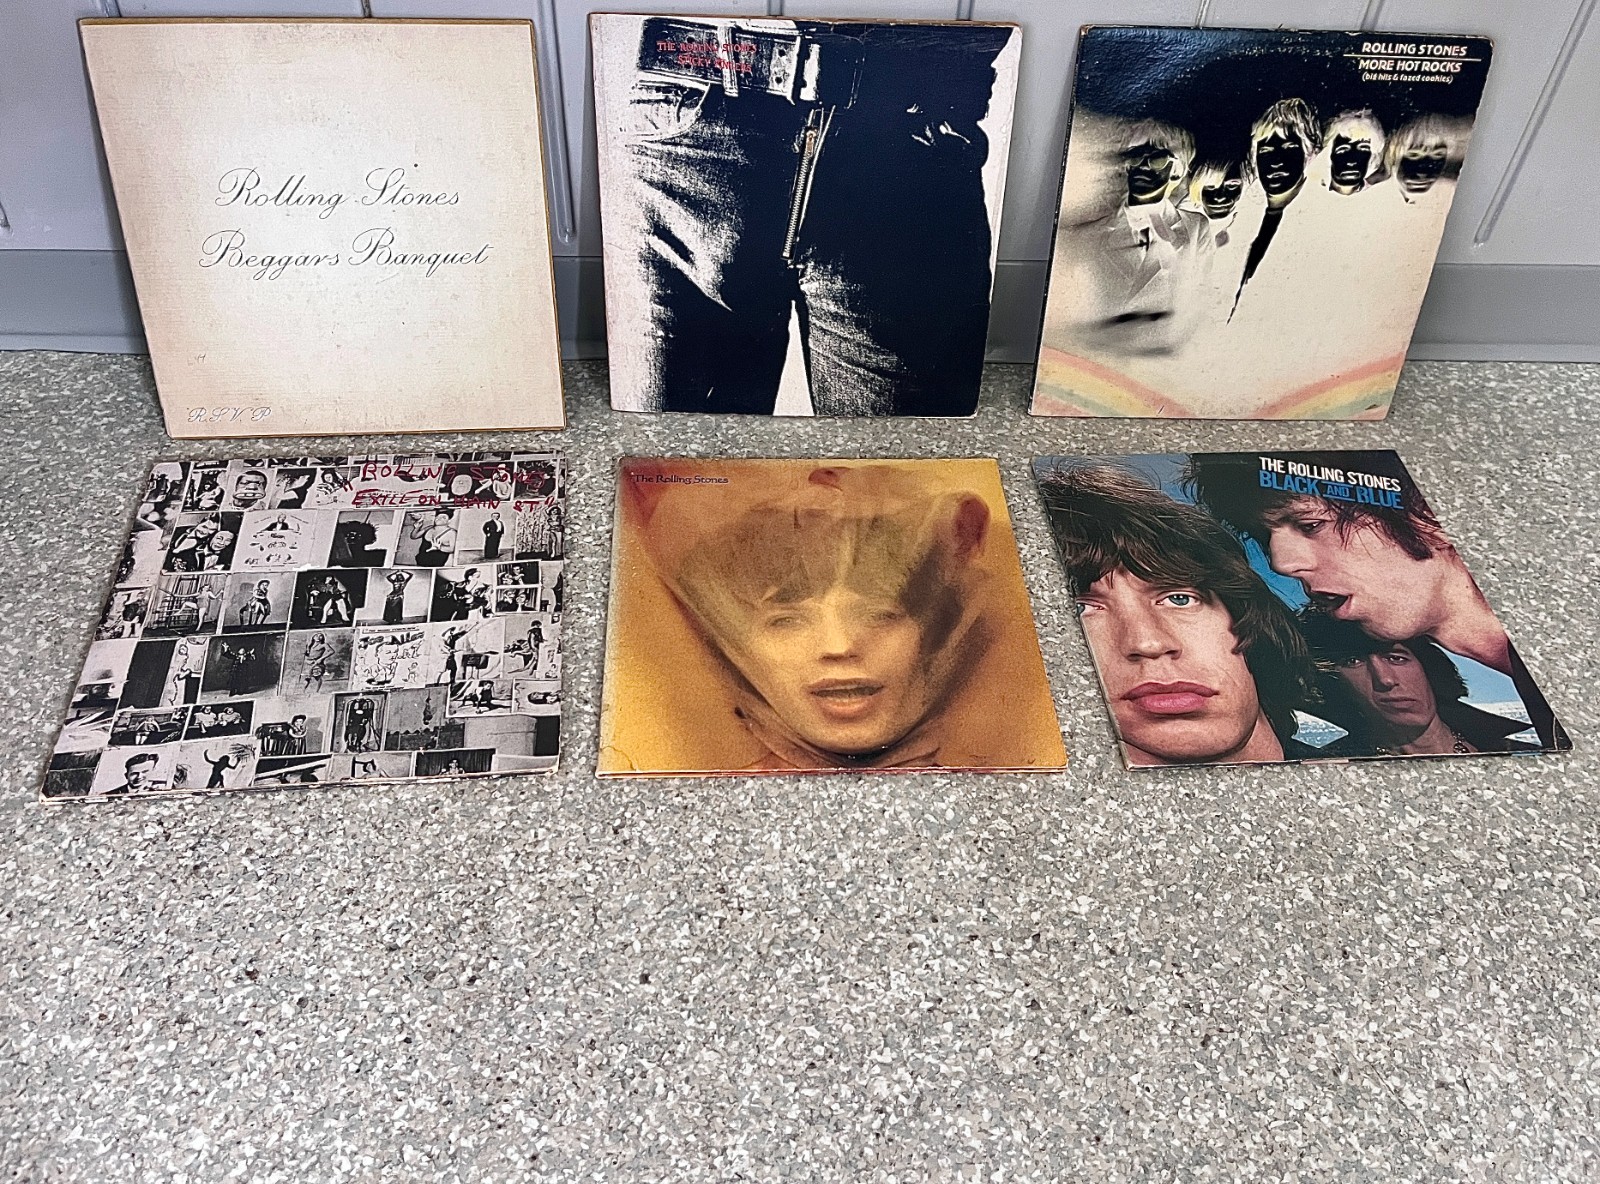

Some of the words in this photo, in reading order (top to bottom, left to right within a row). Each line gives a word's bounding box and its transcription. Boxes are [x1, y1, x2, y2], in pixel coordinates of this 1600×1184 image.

[656, 41, 677, 52] THE
[1362, 42, 1416, 54] ROLLING
[1418, 44, 1468, 56] STONES
[1359, 59, 1395, 71] MORE
[1396, 61, 1422, 72] HOT
[1421, 61, 1462, 72] ROCKS
[215, 167, 350, 219] Rolling
[361, 167, 459, 205] Stones
[199, 228, 340, 280] Beggars
[348, 227, 494, 278] Banquet
[361, 460, 457, 482] ROLLING
[635, 474, 655, 483] The
[656, 474, 691, 485] Rolling
[693, 474, 729, 484] Stones
[1259, 456, 1286, 474] THE
[1288, 461, 1345, 483] ROLLING
[1347, 471, 1402, 492] STONES
[1259, 470, 1321, 497] BLACK
[1327, 484, 1350, 497] AND
[1356, 486, 1405, 509] BLUE
[418, 495, 442, 506] ON
